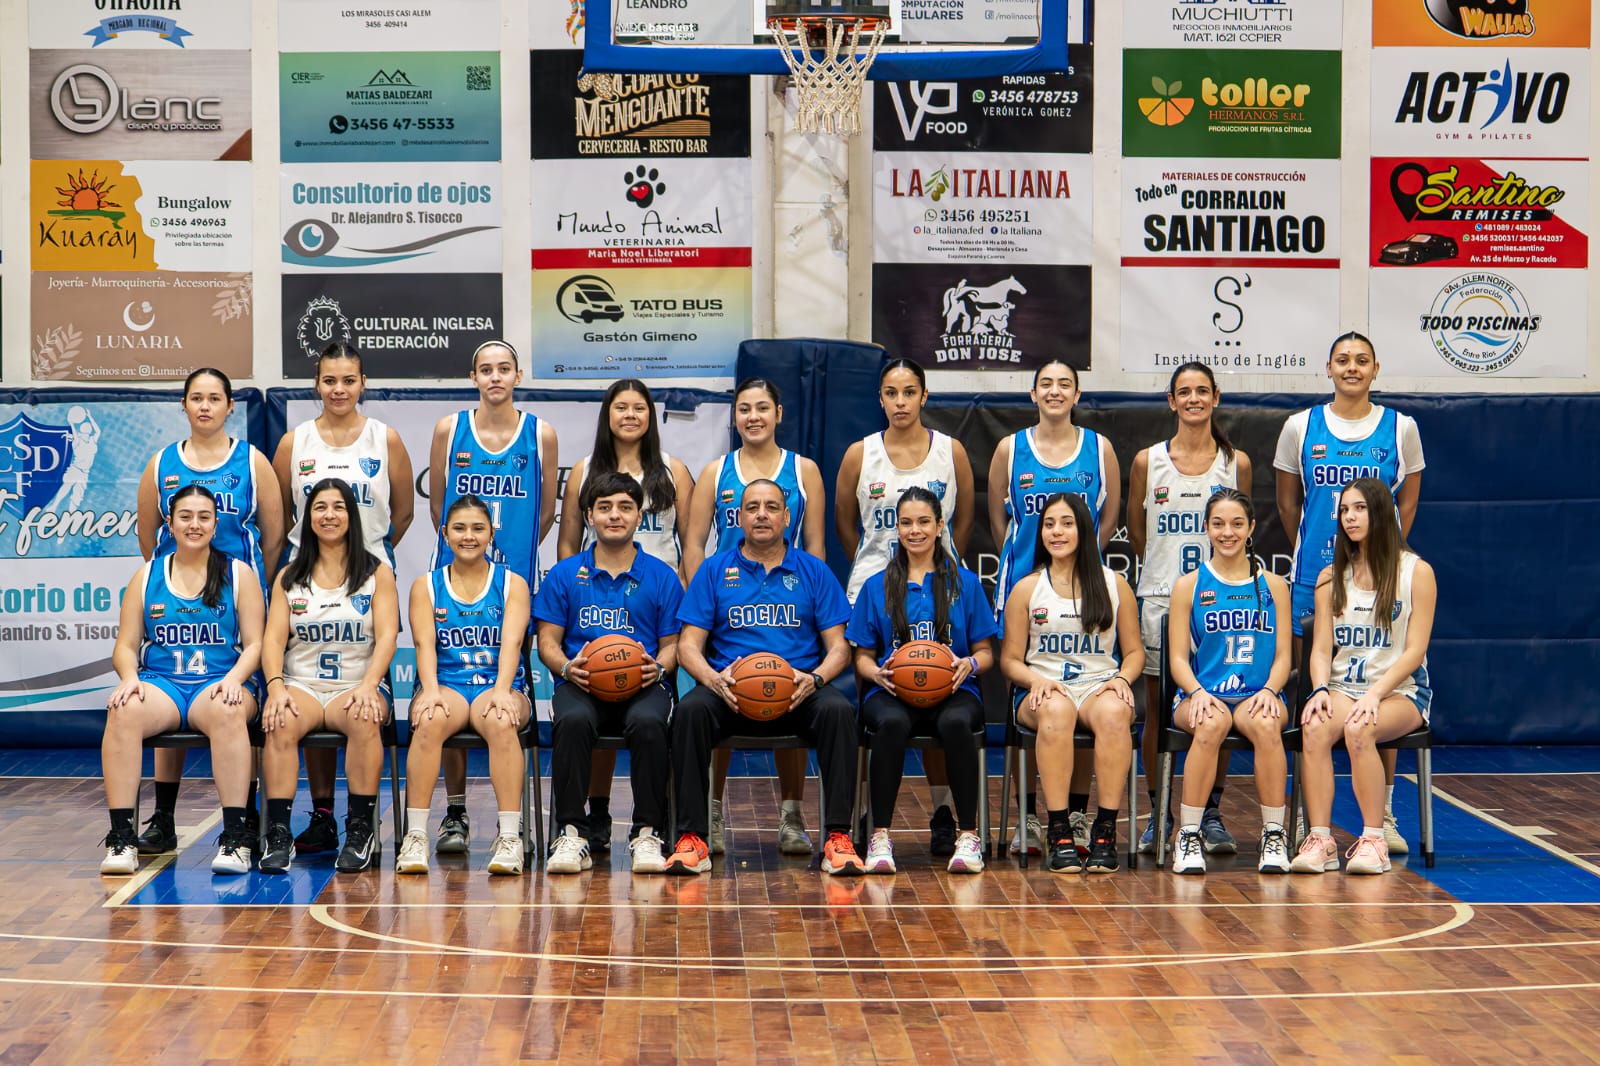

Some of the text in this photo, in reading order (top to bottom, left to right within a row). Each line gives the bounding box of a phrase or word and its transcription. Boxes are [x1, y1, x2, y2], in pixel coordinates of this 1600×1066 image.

[626, 0, 688, 9] LEANDRO
[341, 10, 355, 18] LOS
[1172, 8, 1293, 21] MUCHIUTTI
[1459, 6, 1533, 36] WALLAS
[1222, 24, 1292, 32] INMOBILIARIOS
[1184, 33, 1214, 42] MAT.
[1239, 34, 1282, 42] CCPIER
[1002, 76, 1046, 85] RAPIDAS
[346, 90, 432, 100] MATIAS BALDEZARI
[989, 90, 1078, 103] 3456 478753
[1202, 77, 1310, 107] toller
[574, 85, 710, 137] MENGUANTE
[982, 104, 1072, 117] VERÓNICA GOMEZ
[1209, 110, 1278, 120] HERMANOS
[351, 118, 455, 130] 3456 47-5533
[926, 122, 968, 134] FOOD
[578, 139, 708, 154] CERVECERIA RESTO BAR
[892, 168, 1071, 198] LA ITALIANA
[1162, 171, 1306, 181] MATERIALES DE CONSTRUCCIÓN
[292, 182, 491, 205] Consultorio de ojos
[1136, 183, 1177, 203] Todo en
[1416, 166, 1565, 214] Santino
[158, 196, 232, 211] Bungalow
[1181, 190, 1286, 210] CORRALON
[332, 211, 463, 225] Dr. Alejandro S. Tisocco
[557, 207, 722, 236] Mundo Animal
[940, 210, 1030, 222] 3456 495251
[1452, 210, 1533, 220] REMISES
[162, 218, 226, 227] 3456 496963
[924, 226, 984, 236] la_italiana.fed
[1010, 226, 1042, 236] Italiana
[1144, 214, 1325, 253] SANTIAGO
[40, 220, 137, 259] Kuaray
[588, 249, 699, 258] Maria Noel Liberatori
[1462, 275, 1485, 285] ALEM
[1486, 275, 1514, 294] NORTE
[1460, 287, 1503, 300] Federación
[630, 300, 722, 310] TATO BUS
[354, 318, 494, 330] CULTURAL INGLESA
[1422, 316, 1540, 330] TODO PISCINAS
[96, 335, 183, 349] LUNARIA
[358, 333, 448, 349] FEDERACIÓN
[584, 331, 697, 342] Gastón Gimeno
[943, 334, 1013, 348] FORRAJERIA
[935, 349, 1023, 363] DON JOSE
[1155, 354, 1306, 368] Instituto de Inglés
[76, 366, 136, 378] Seguinos en:
[457, 474, 527, 498] SOCIAL
[74, 582, 111, 612] de
[579, 605, 634, 633] SOCIAL
[728, 604, 800, 628] SOCIAL
[1204, 609, 1274, 634] SOCIAL
[56, 623, 71, 640] S.
[155, 623, 225, 646] SOCIAL
[296, 620, 369, 644] SOCIAL
[438, 626, 501, 649] SOCIAL
[1334, 624, 1393, 649] SOCIAL
[1038, 632, 1106, 656] SOCIAL
[1224, 635, 1254, 664] 12
[172, 650, 208, 674] 14
[316, 650, 342, 680] 5
